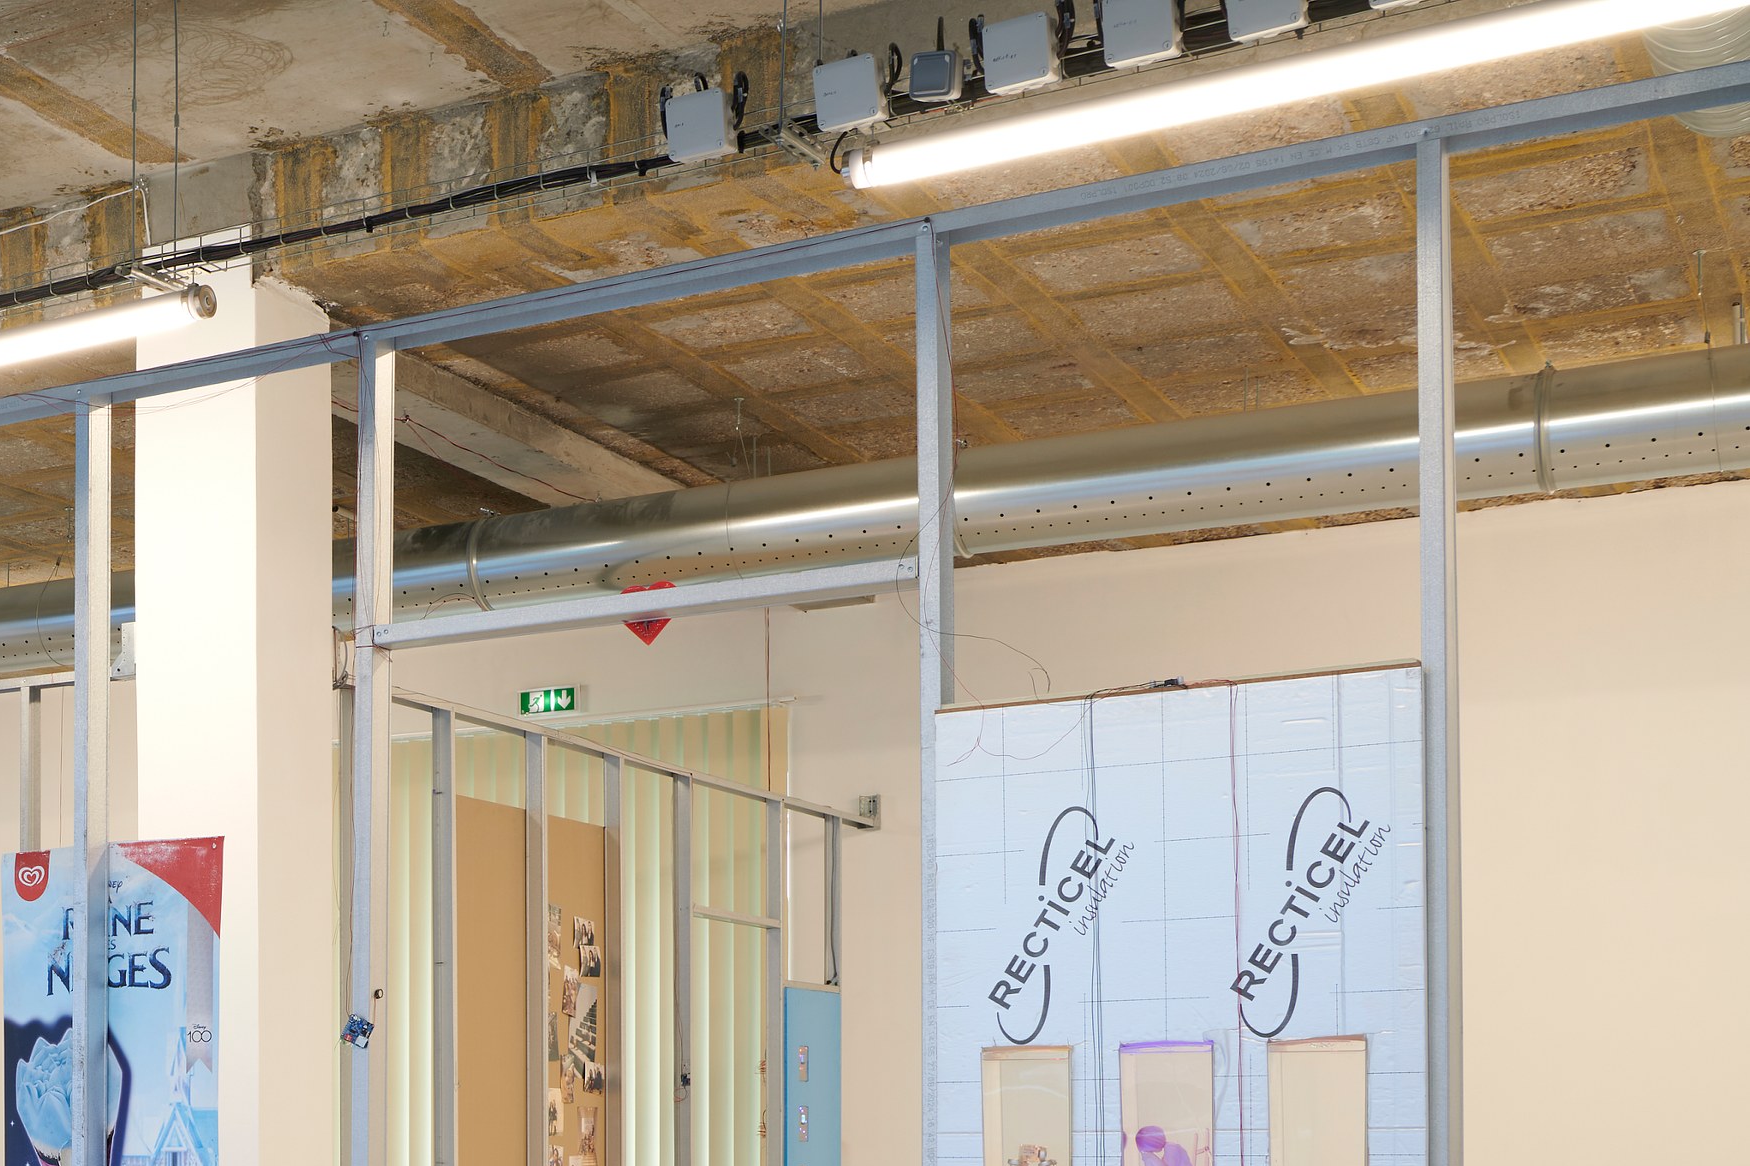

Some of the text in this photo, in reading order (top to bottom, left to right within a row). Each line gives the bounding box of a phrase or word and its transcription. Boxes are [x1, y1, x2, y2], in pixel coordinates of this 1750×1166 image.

[1068, 841, 1136, 937] insulation
[1324, 823, 1392, 924] insulation
[46, 947, 172, 996] NGES
[187, 1030, 213, 1043] 100
